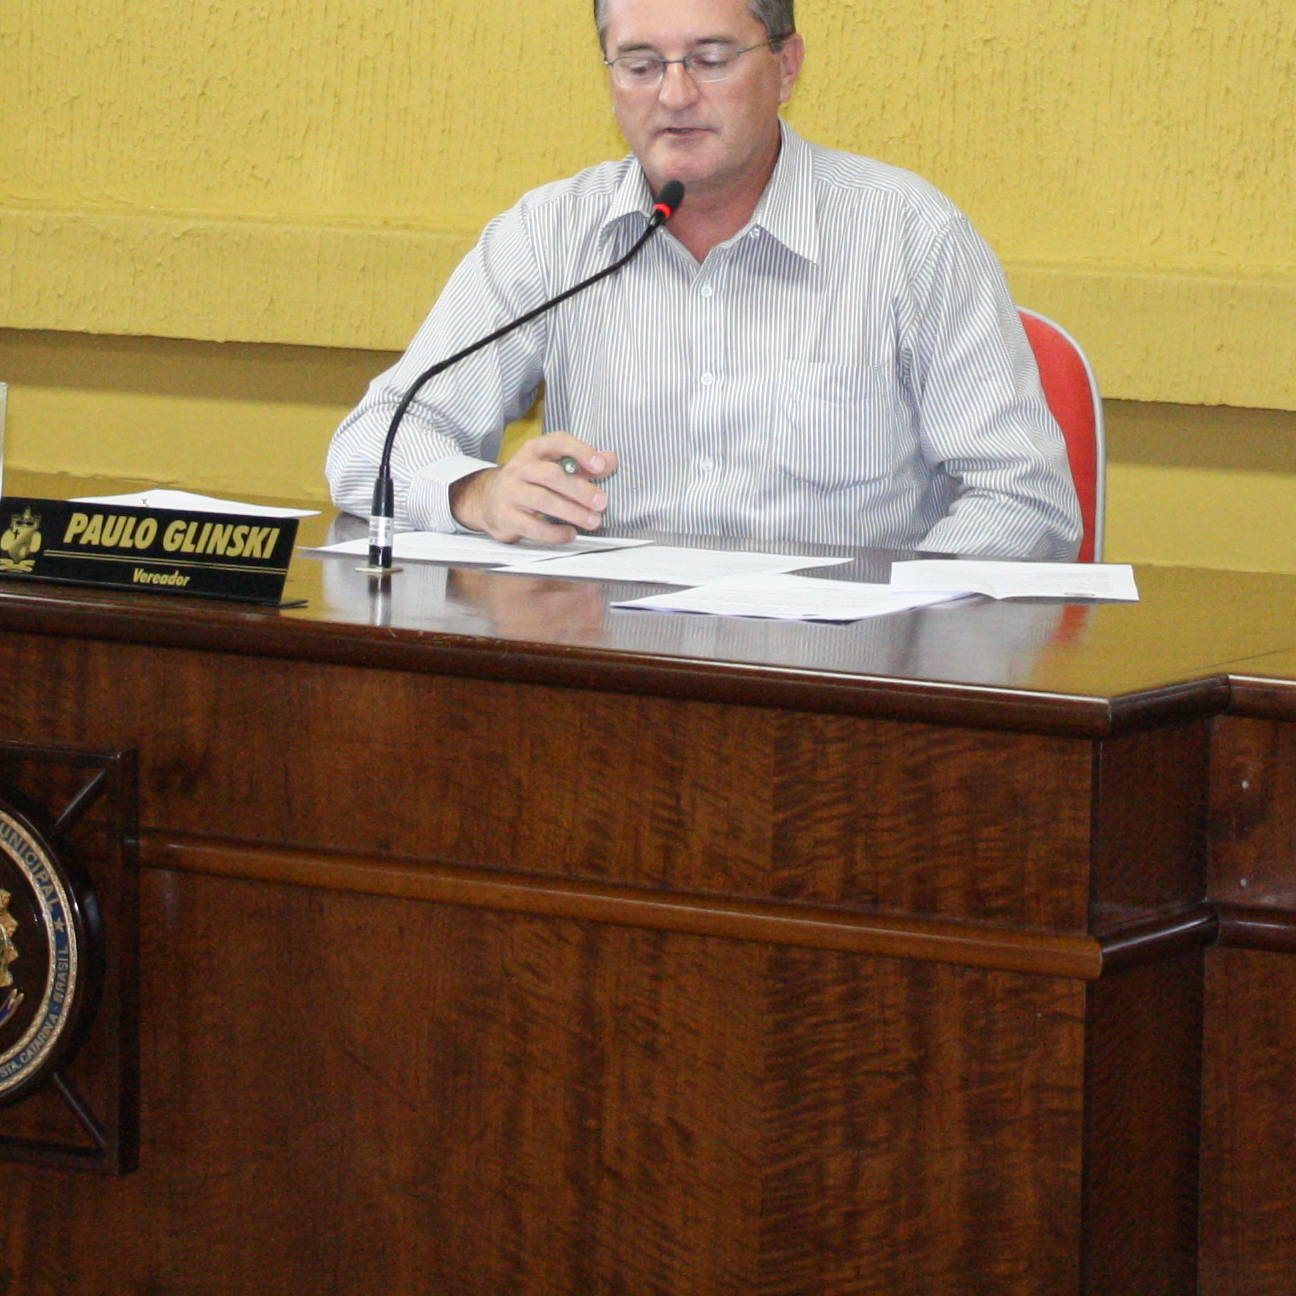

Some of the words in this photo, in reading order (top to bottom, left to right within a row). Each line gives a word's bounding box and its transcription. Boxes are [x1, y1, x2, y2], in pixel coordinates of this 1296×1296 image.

[63, 512, 158, 550] PAULO
[162, 520, 280, 560] GLINSKI
[132, 567, 191, 588] Vereador
[54, 945, 69, 1000] BRASIL
